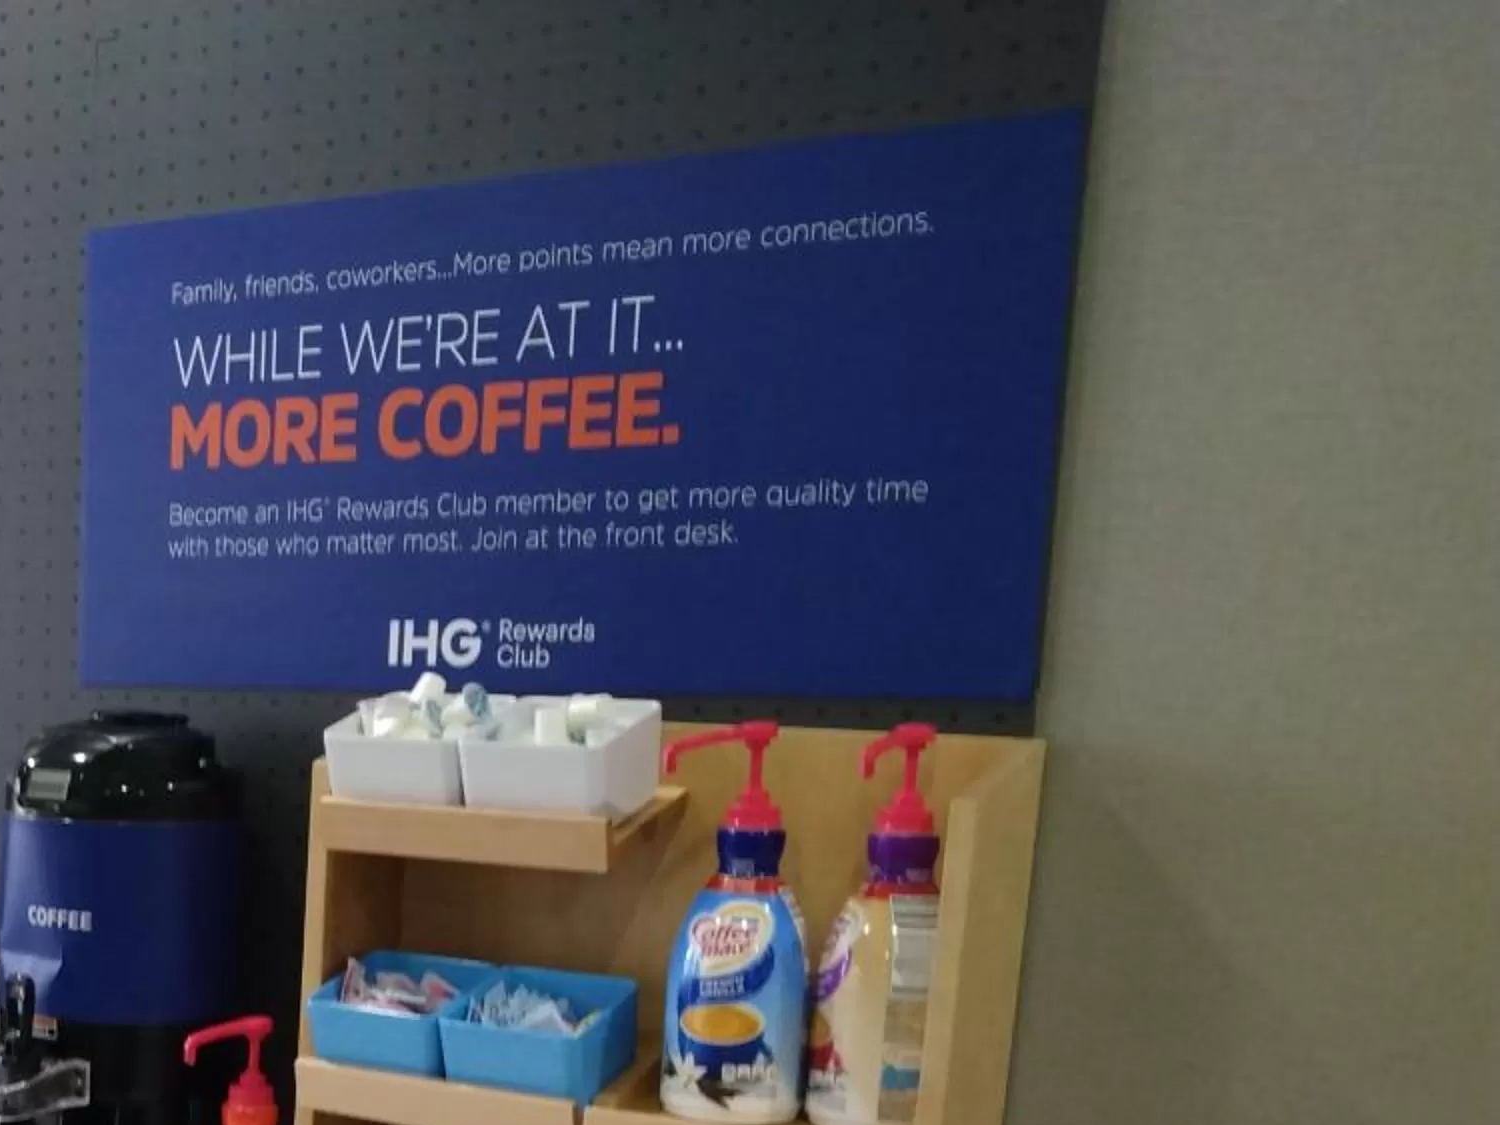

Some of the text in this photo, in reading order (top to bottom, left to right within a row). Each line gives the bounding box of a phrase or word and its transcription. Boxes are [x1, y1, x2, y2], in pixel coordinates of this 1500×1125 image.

[171, 278, 238, 306] Family,
[245, 271, 320, 298] friends,
[519, 243, 593, 274] points
[603, 236, 673, 261] mean
[683, 229, 751, 255] more
[761, 210, 936, 248] connections.
[173, 295, 684, 389] WHILE WE'RE AT IT...
[169, 370, 681, 471] MORE COFFEE.
[168, 502, 249, 527] Become
[254, 503, 280, 525] an
[336, 496, 430, 522] Rewards
[437, 491, 488, 518] Club
[495, 488, 597, 516] member
[605, 488, 630, 512] to
[638, 484, 679, 515] get
[688, 482, 758, 509] more
[767, 479, 858, 508] quality
[866, 477, 930, 503] time
[168, 517, 740, 559] with those who matter most. Join at the front desk.
[499, 617, 596, 643] Rewards
[497, 644, 551, 669] Club
[27, 904, 93, 932] COFFEE
